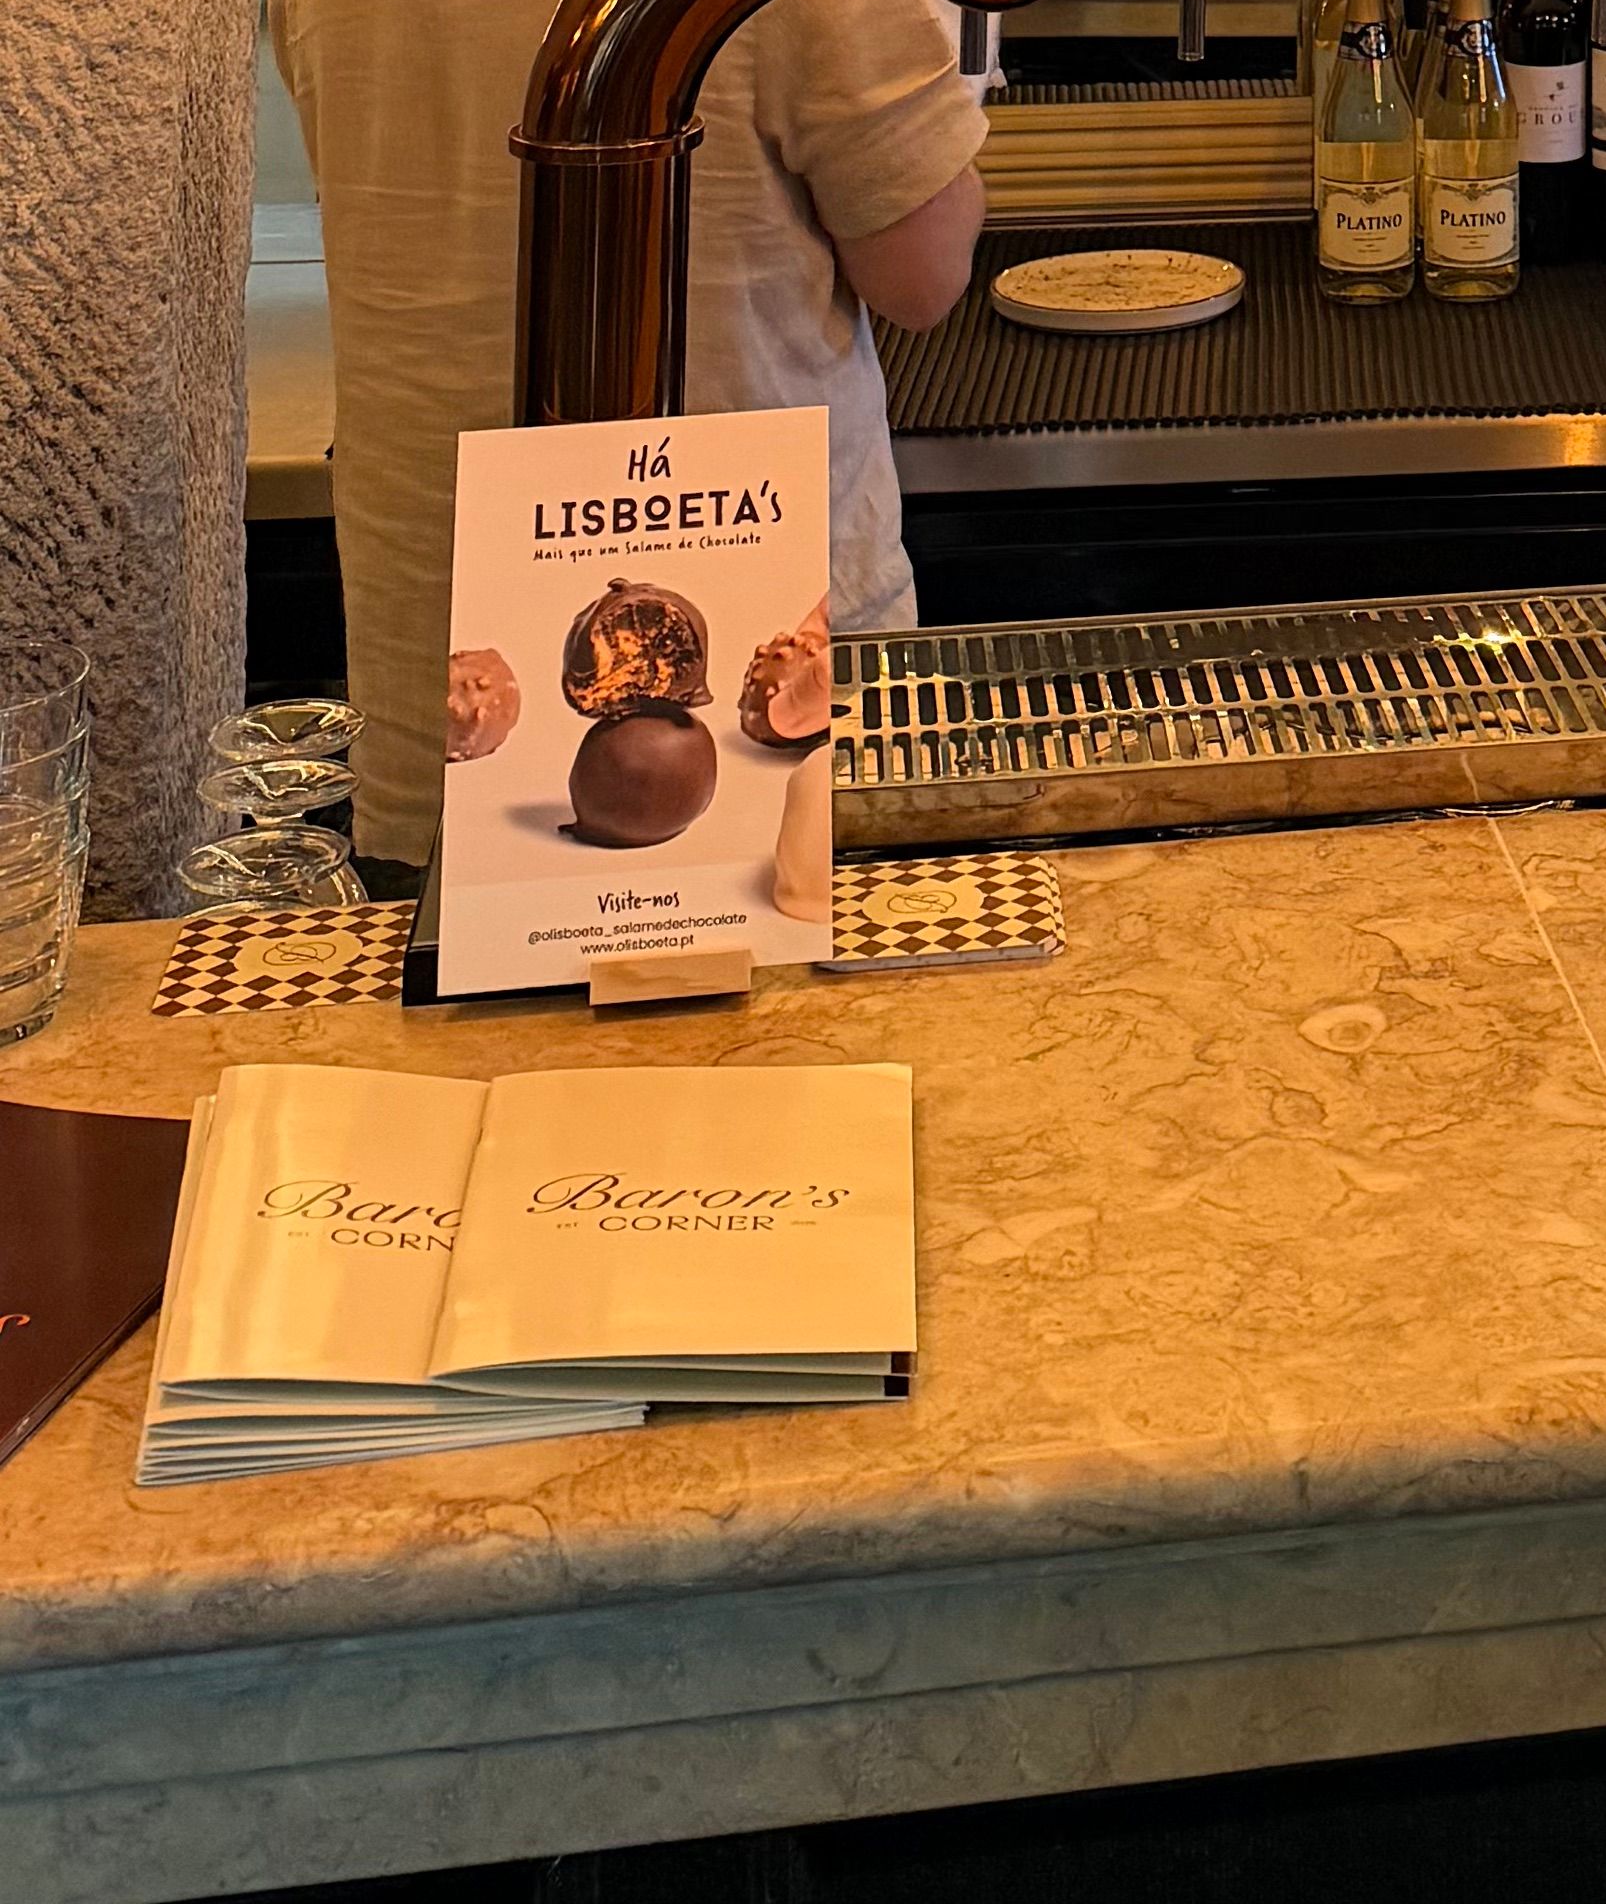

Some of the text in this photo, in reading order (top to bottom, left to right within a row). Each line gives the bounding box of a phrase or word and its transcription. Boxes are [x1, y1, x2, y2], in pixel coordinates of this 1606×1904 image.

[1336, 212, 1403, 231] PLATINO
[1440, 209, 1506, 227] PLATINO
[628, 436, 672, 482] Há
[534, 480, 783, 540] LISBOETA'S
[533, 532, 762, 563] Mais que um Salame de Chocolate
[597, 889, 680, 914] Visite-nos
[527, 913, 748, 945] @olisboeta_salamedechocolate
[579, 934, 695, 955] www.olisboeta.pt
[526, 1172, 850, 1213] Baron's
[598, 1215, 775, 1232] CORNER
[330, 1228, 455, 1252] CORN
